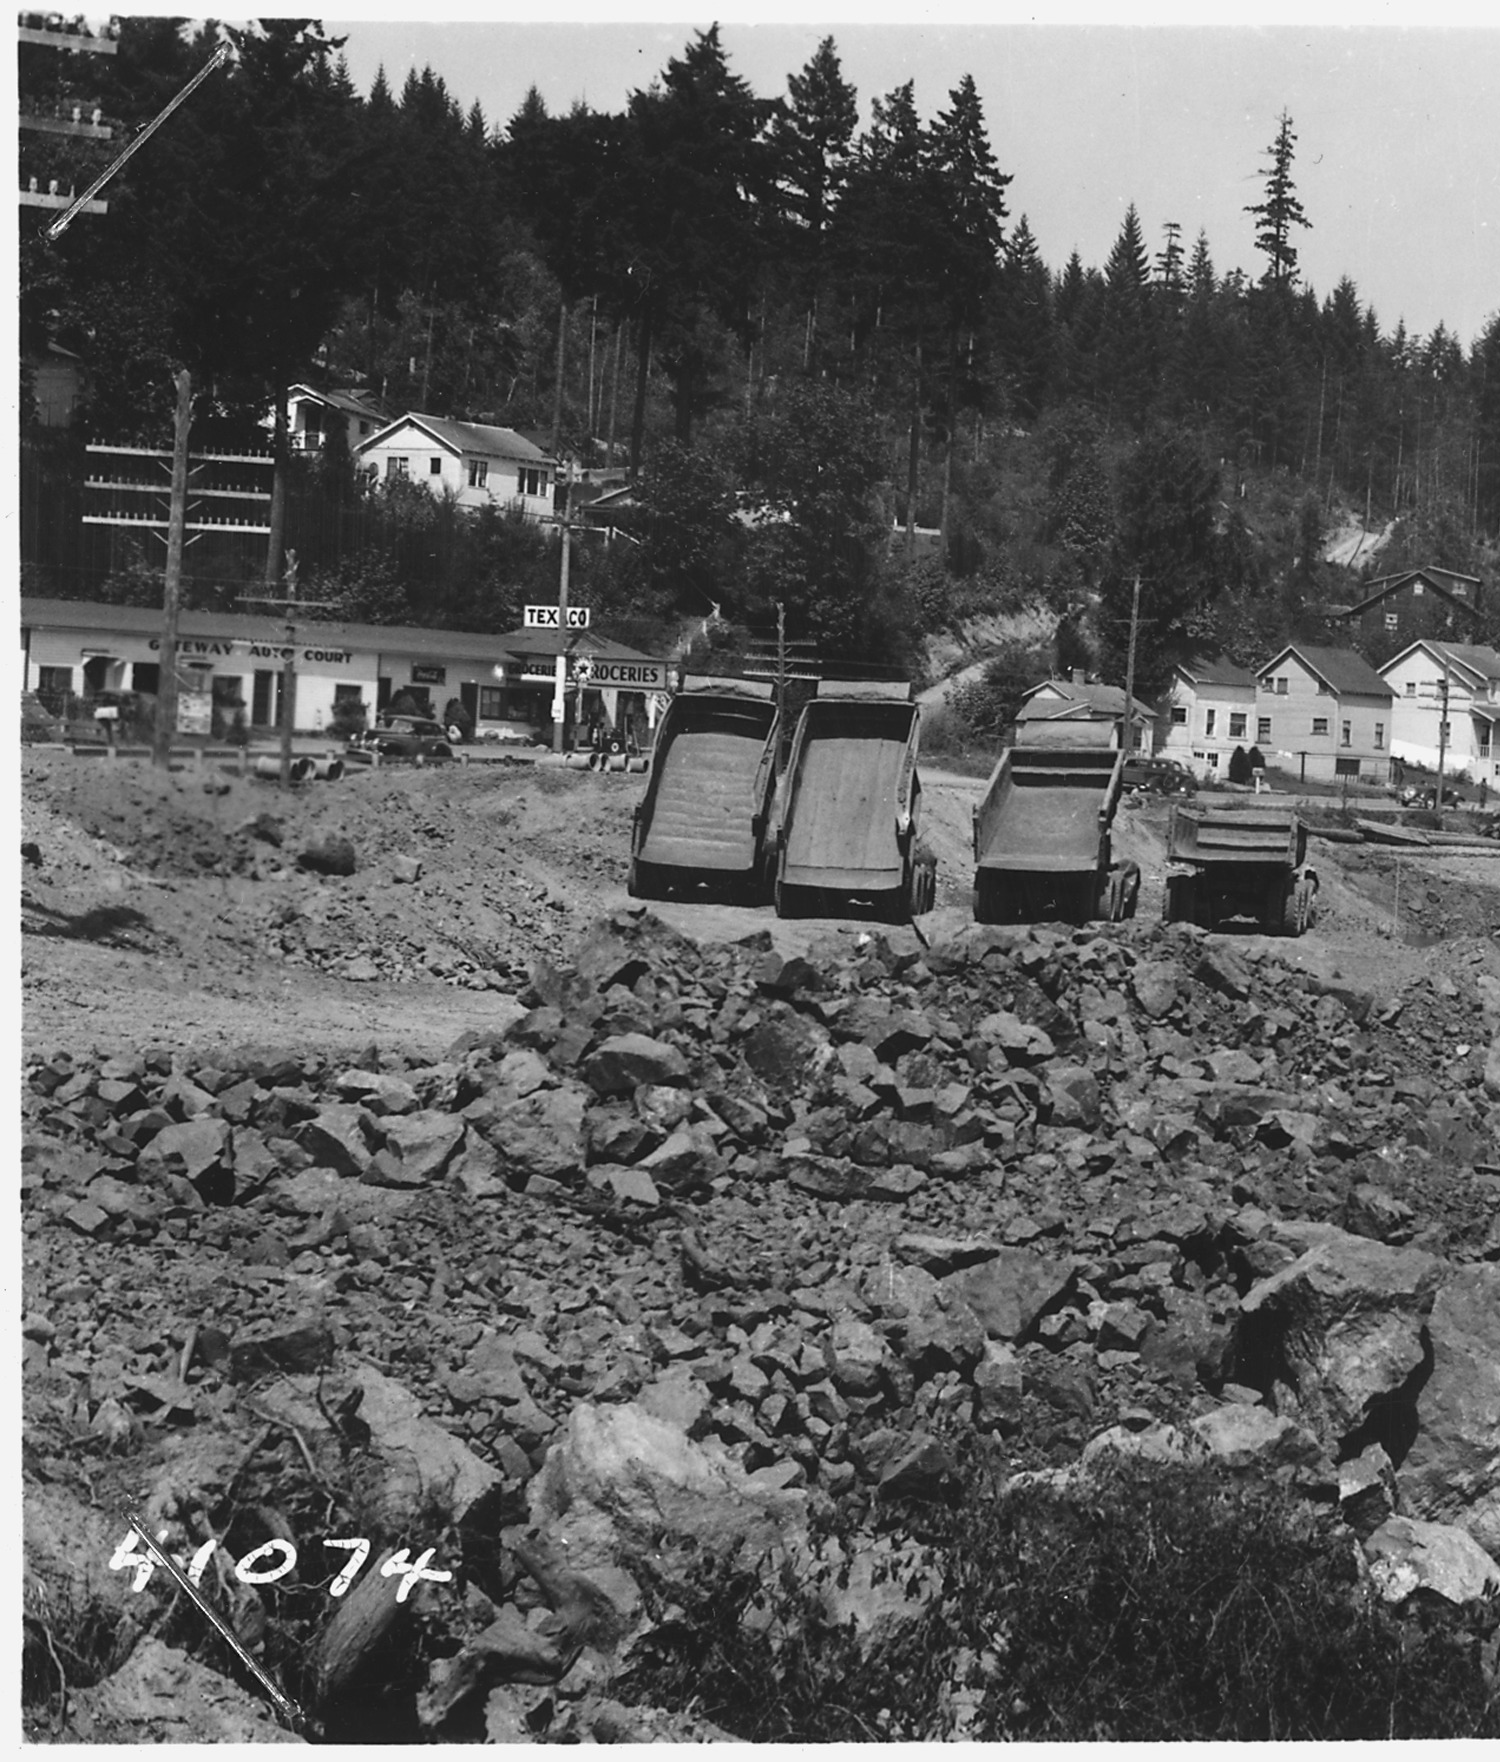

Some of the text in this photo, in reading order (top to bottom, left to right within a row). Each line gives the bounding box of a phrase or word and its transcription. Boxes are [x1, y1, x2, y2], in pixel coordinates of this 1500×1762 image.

[527, 608, 587, 626] TEXCO
[148, 639, 235, 656] GTEWAY
[304, 649, 353, 664] COURT
[508, 662, 557, 678] GROCERIE
[590, 663, 659, 683] ROCERIES
